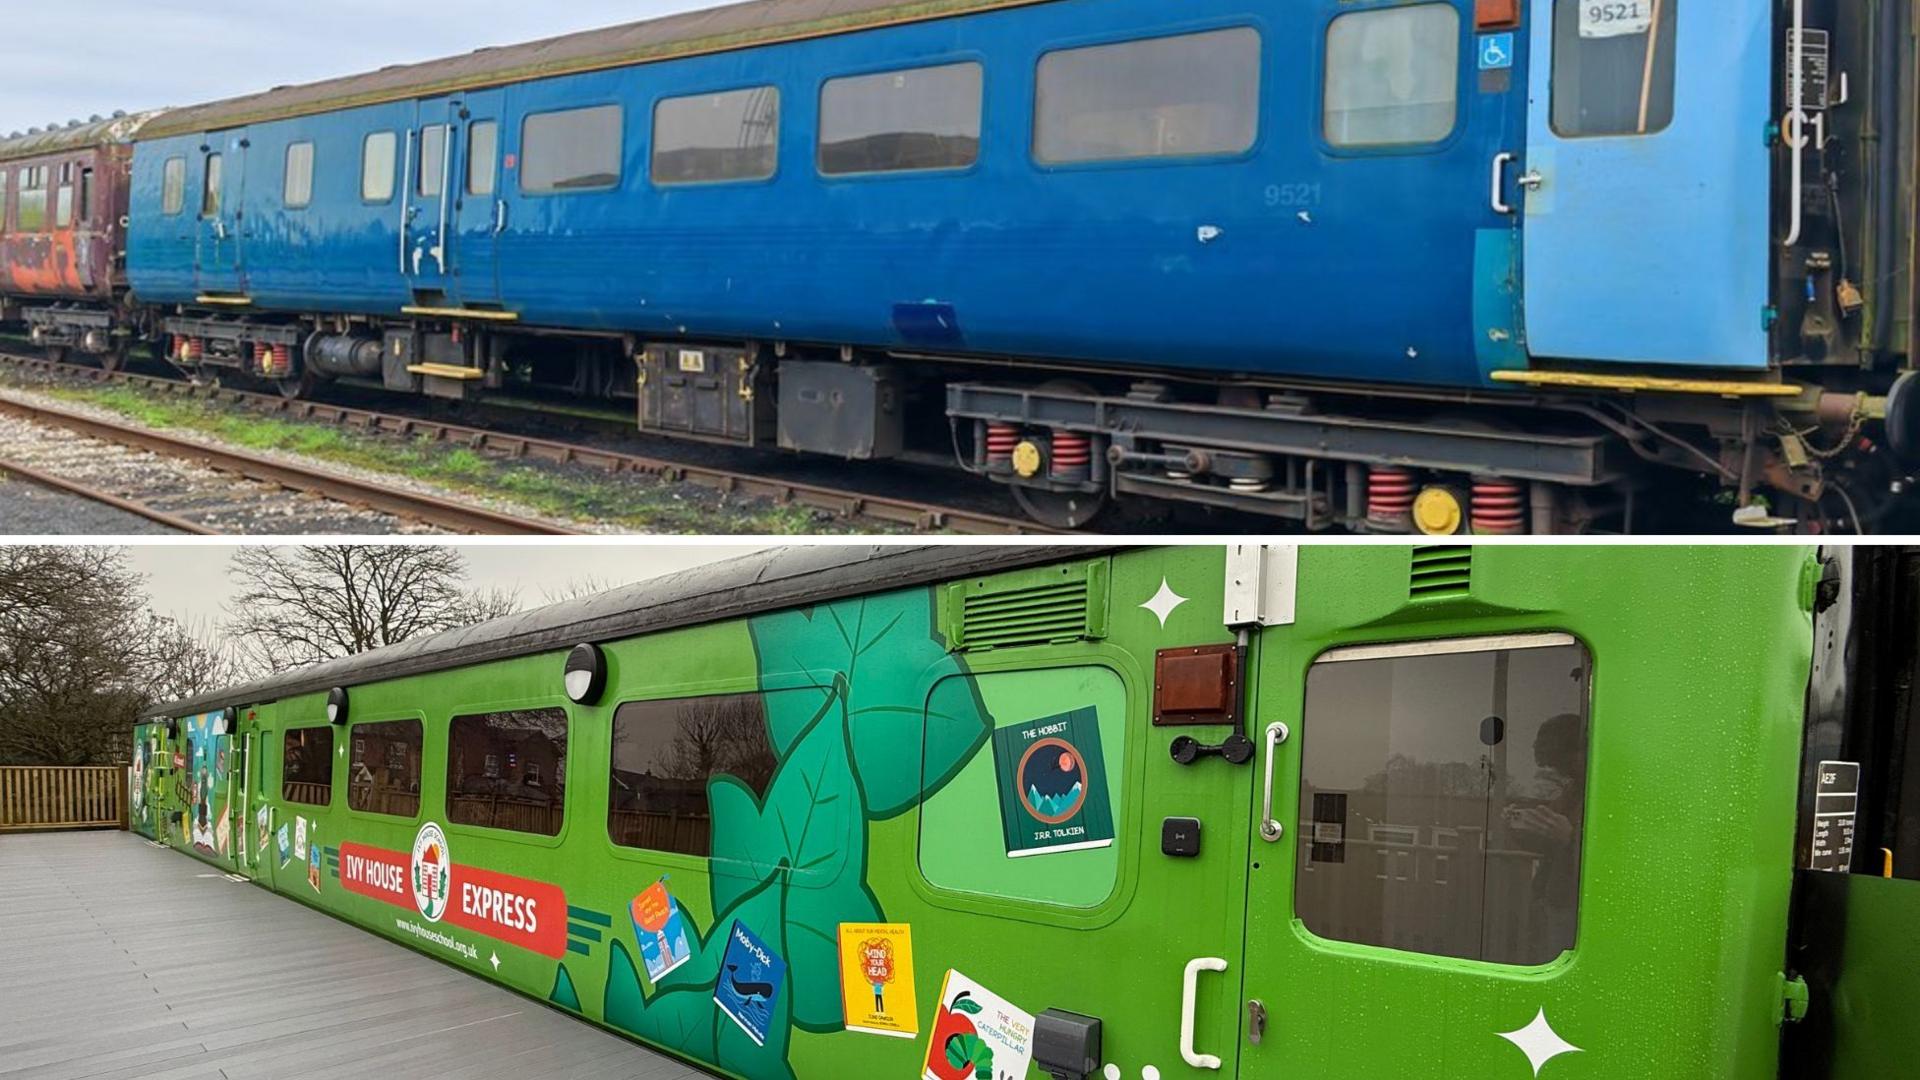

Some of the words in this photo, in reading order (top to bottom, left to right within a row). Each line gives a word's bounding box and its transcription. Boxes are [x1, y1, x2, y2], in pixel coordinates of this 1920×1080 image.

[1589, 3, 1640, 24] 9521
[1782, 111, 1824, 150] C1
[1264, 183, 1321, 207] 9521
[1022, 729, 1037, 740] THE
[1037, 721, 1068, 737] HOBBIT
[1053, 826, 1085, 838] TOLKIEN
[346, 854, 365, 882] IVY
[366, 859, 404, 894] HOUSE
[462, 882, 537, 934] EXPRESS
[396, 918, 478, 960] www.ivyhouseschool.org.uk
[735, 927, 772, 968] Moby-Dick
[868, 966, 887, 977] HEAD
[870, 959, 885, 967] YOUR
[997, 1010, 1011, 1025] THE
[1011, 1020, 1030, 1037] VERY
[999, 1023, 1028, 1044] HUNGRY
[977, 1020, 1025, 1055] CATERPILLAR
